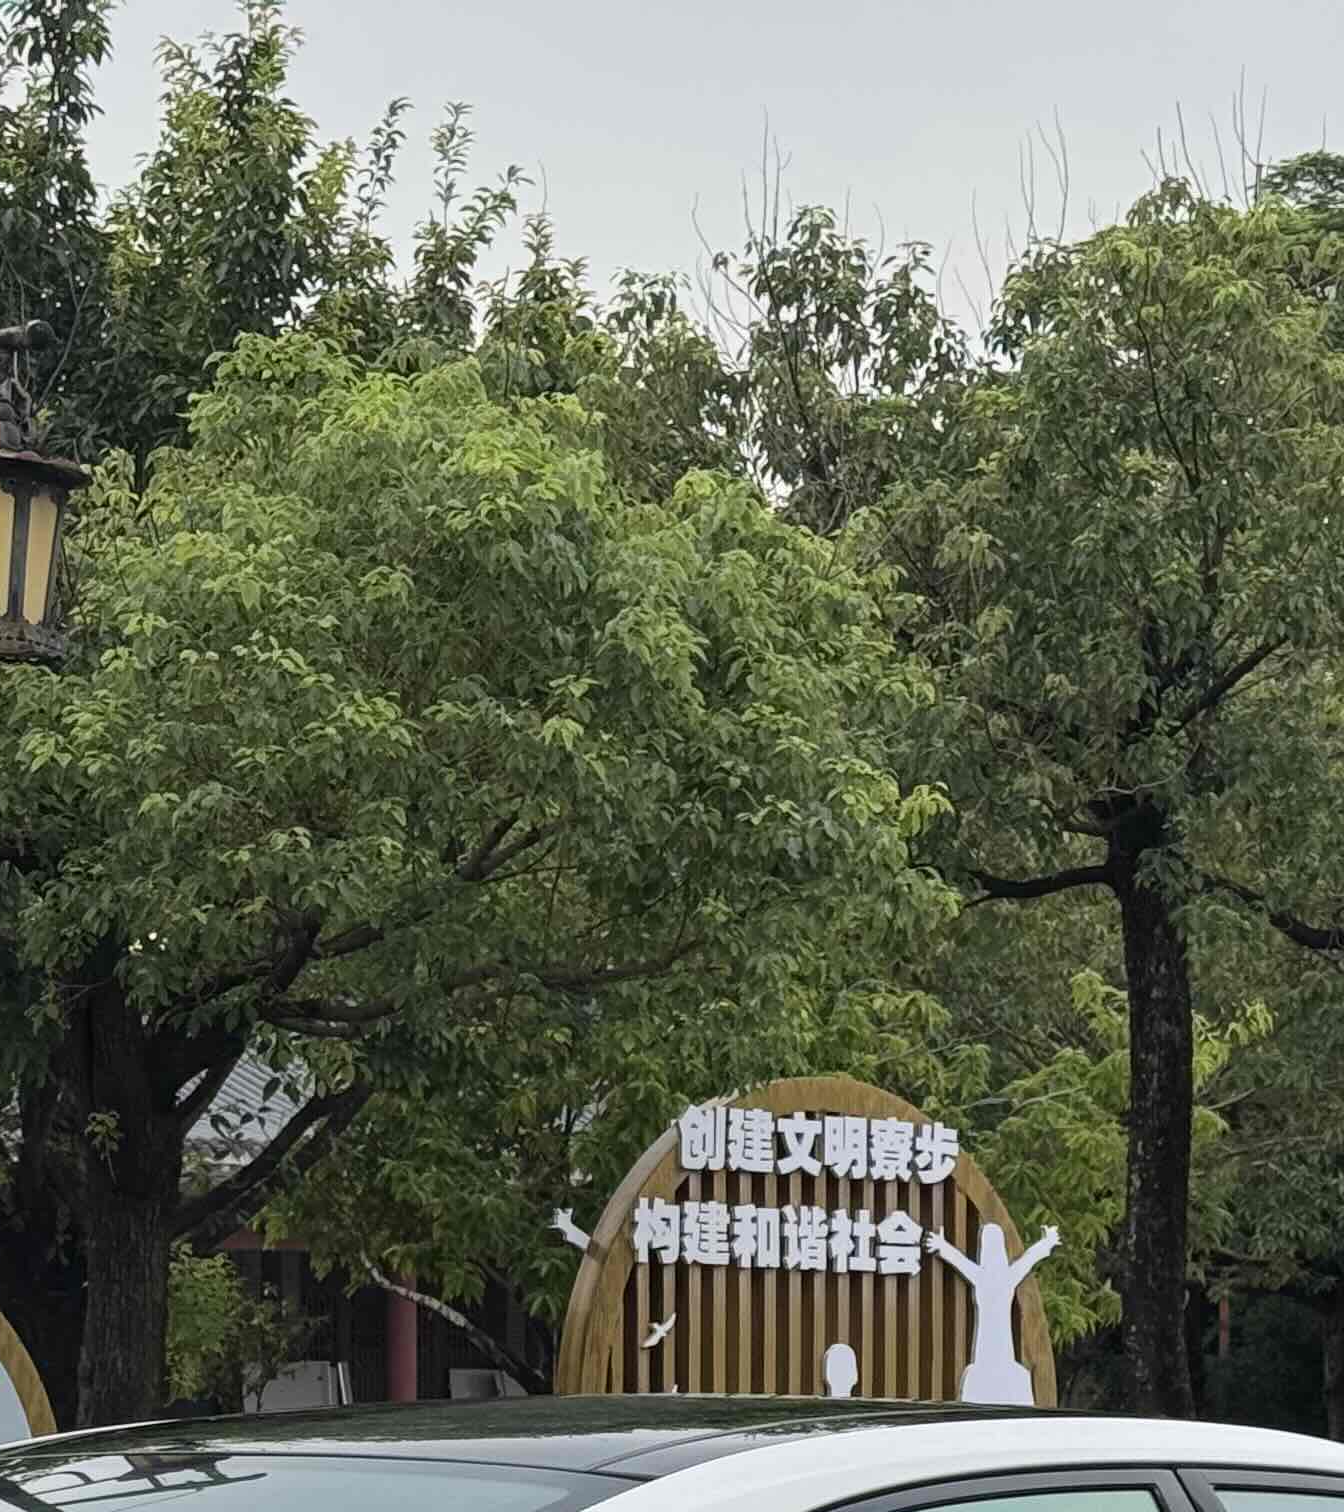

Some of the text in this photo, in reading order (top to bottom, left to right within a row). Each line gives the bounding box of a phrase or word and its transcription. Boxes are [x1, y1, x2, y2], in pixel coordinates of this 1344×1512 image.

[678, 1104, 959, 1184] 创建文明寮步
[632, 1197, 923, 1276] 构建和谐社会
